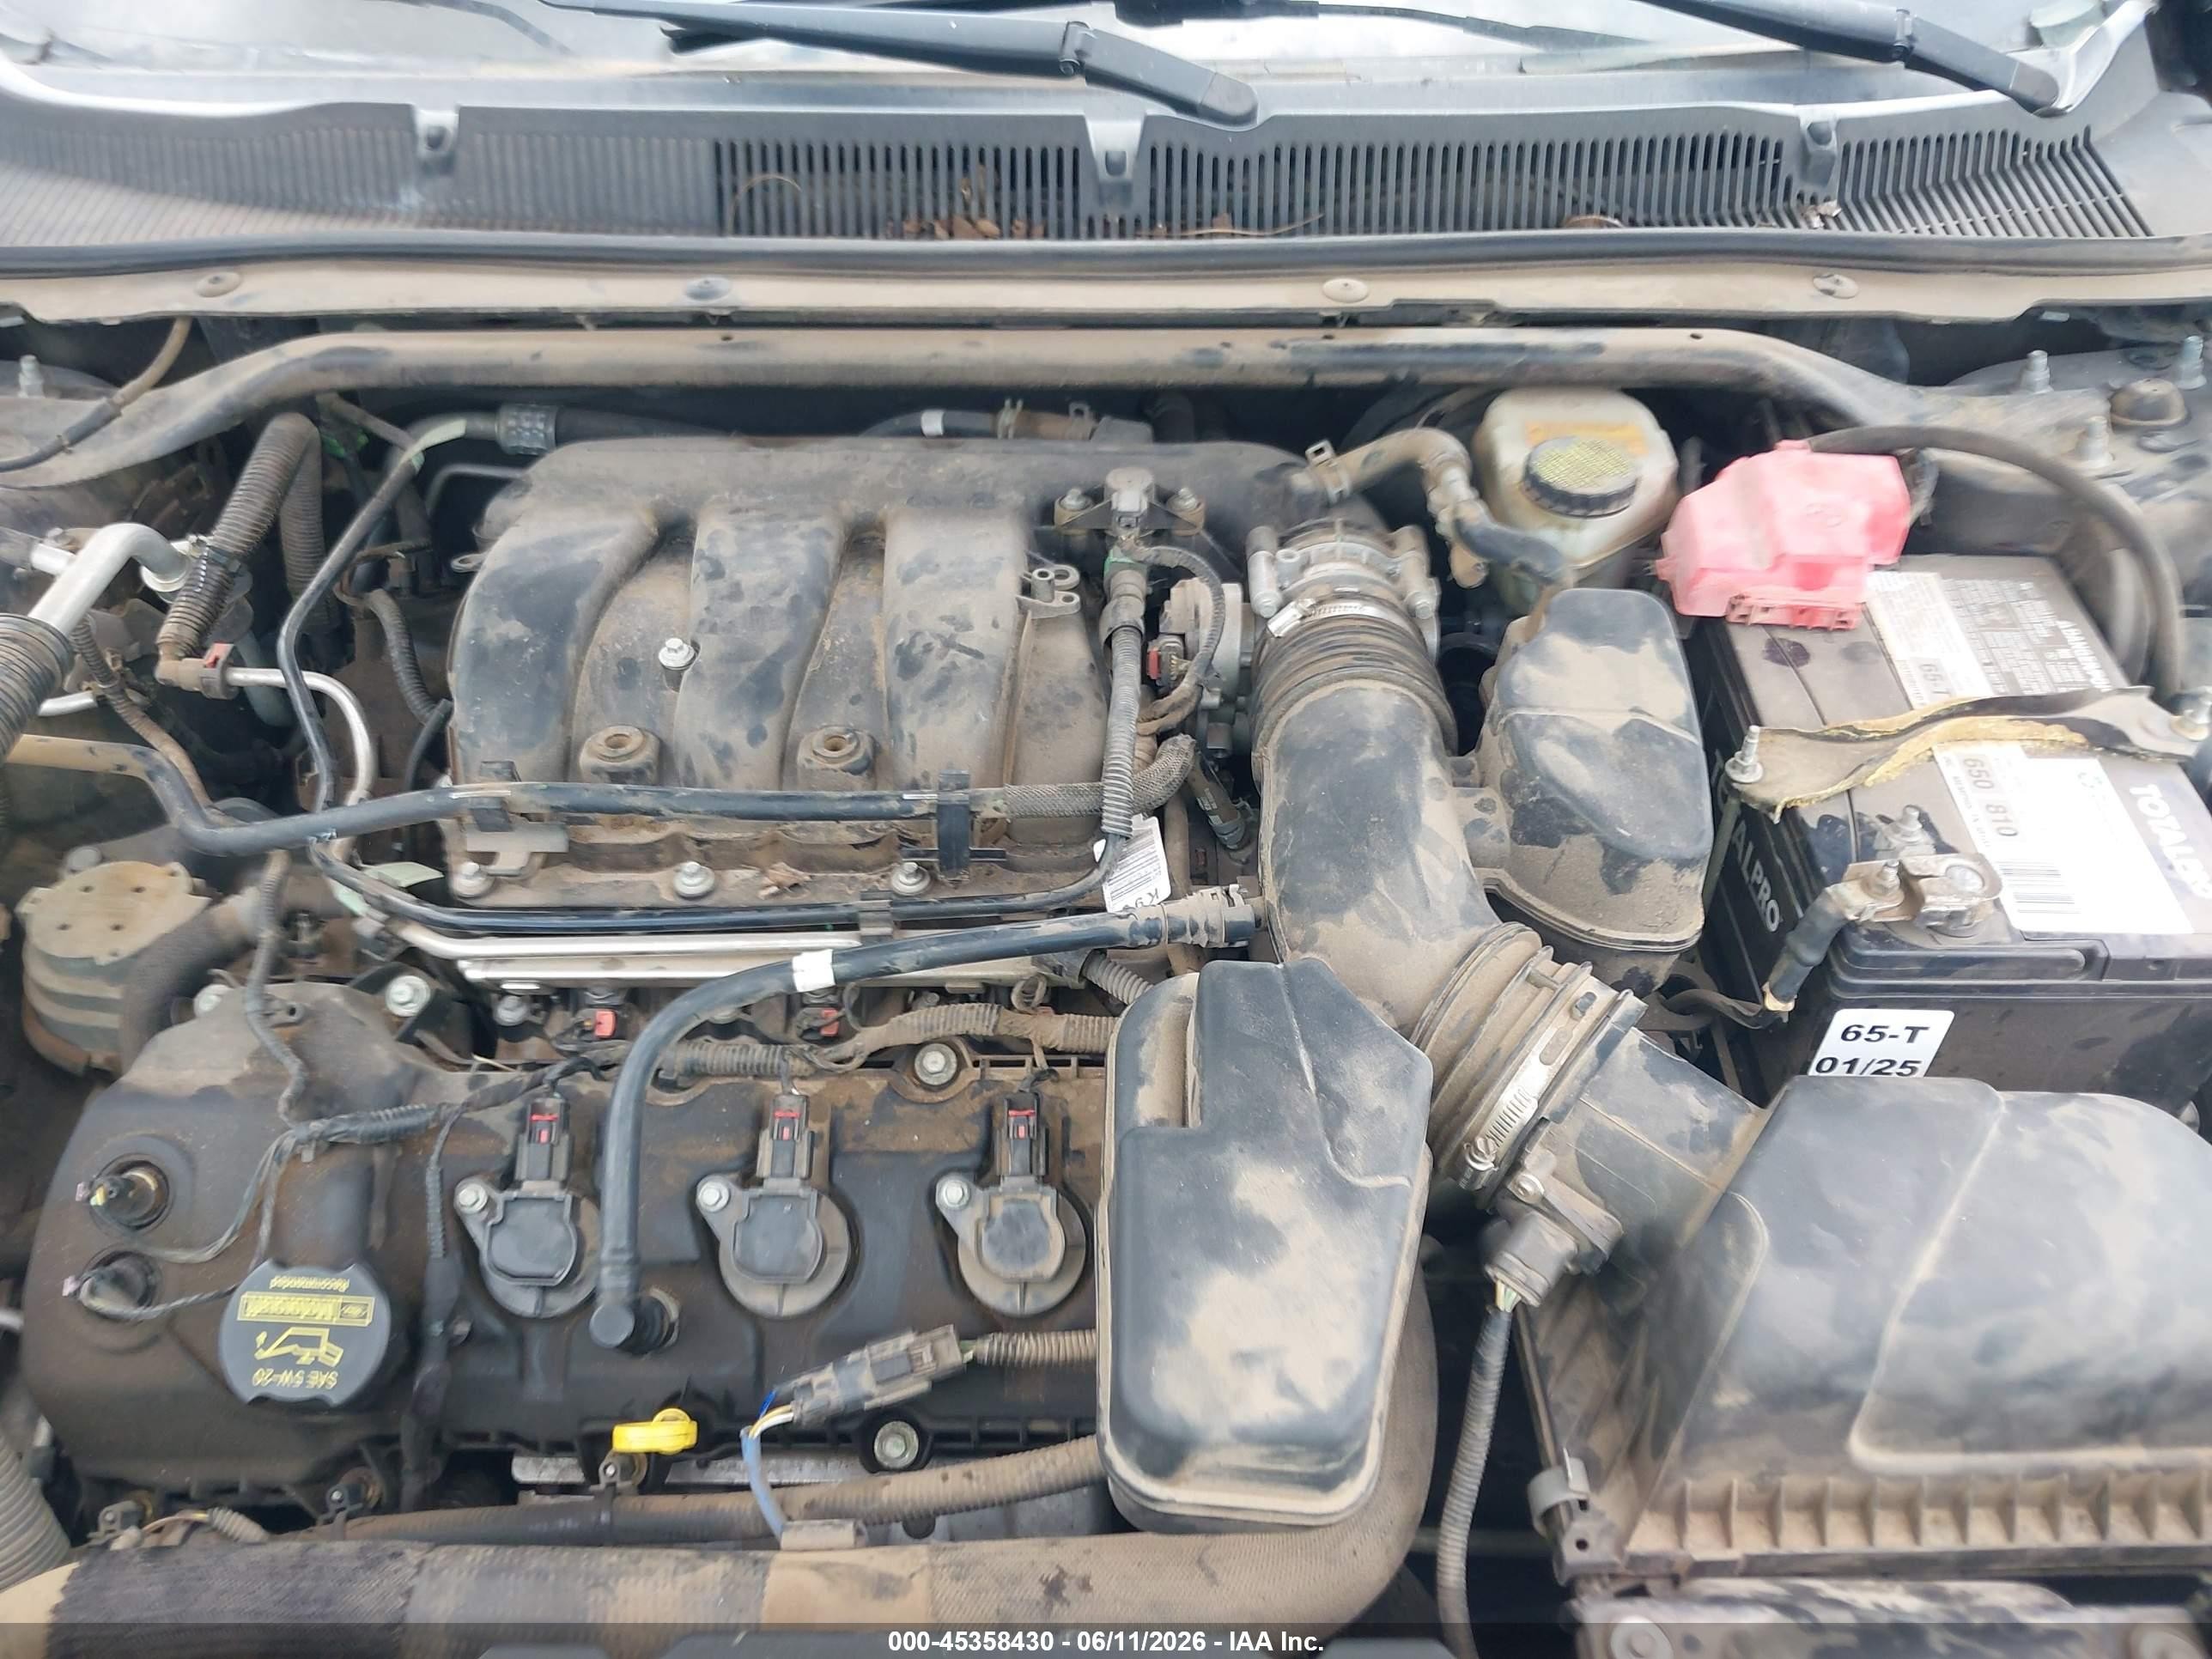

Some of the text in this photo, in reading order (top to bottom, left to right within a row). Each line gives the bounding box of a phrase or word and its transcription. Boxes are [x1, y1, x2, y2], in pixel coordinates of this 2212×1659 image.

[1919, 662, 1950, 695] 65-T
[1963, 757, 1996, 790] 650
[1985, 803, 2019, 837] 810
[2129, 783, 2212, 900] TOTALPRO
[1840, 1024, 1930, 1044] 65-T
[1814, 1056, 1923, 1077] 01/25
[269, 1274, 350, 1292] Recommended
[252, 1367, 338, 1389] SAE 5W-20
